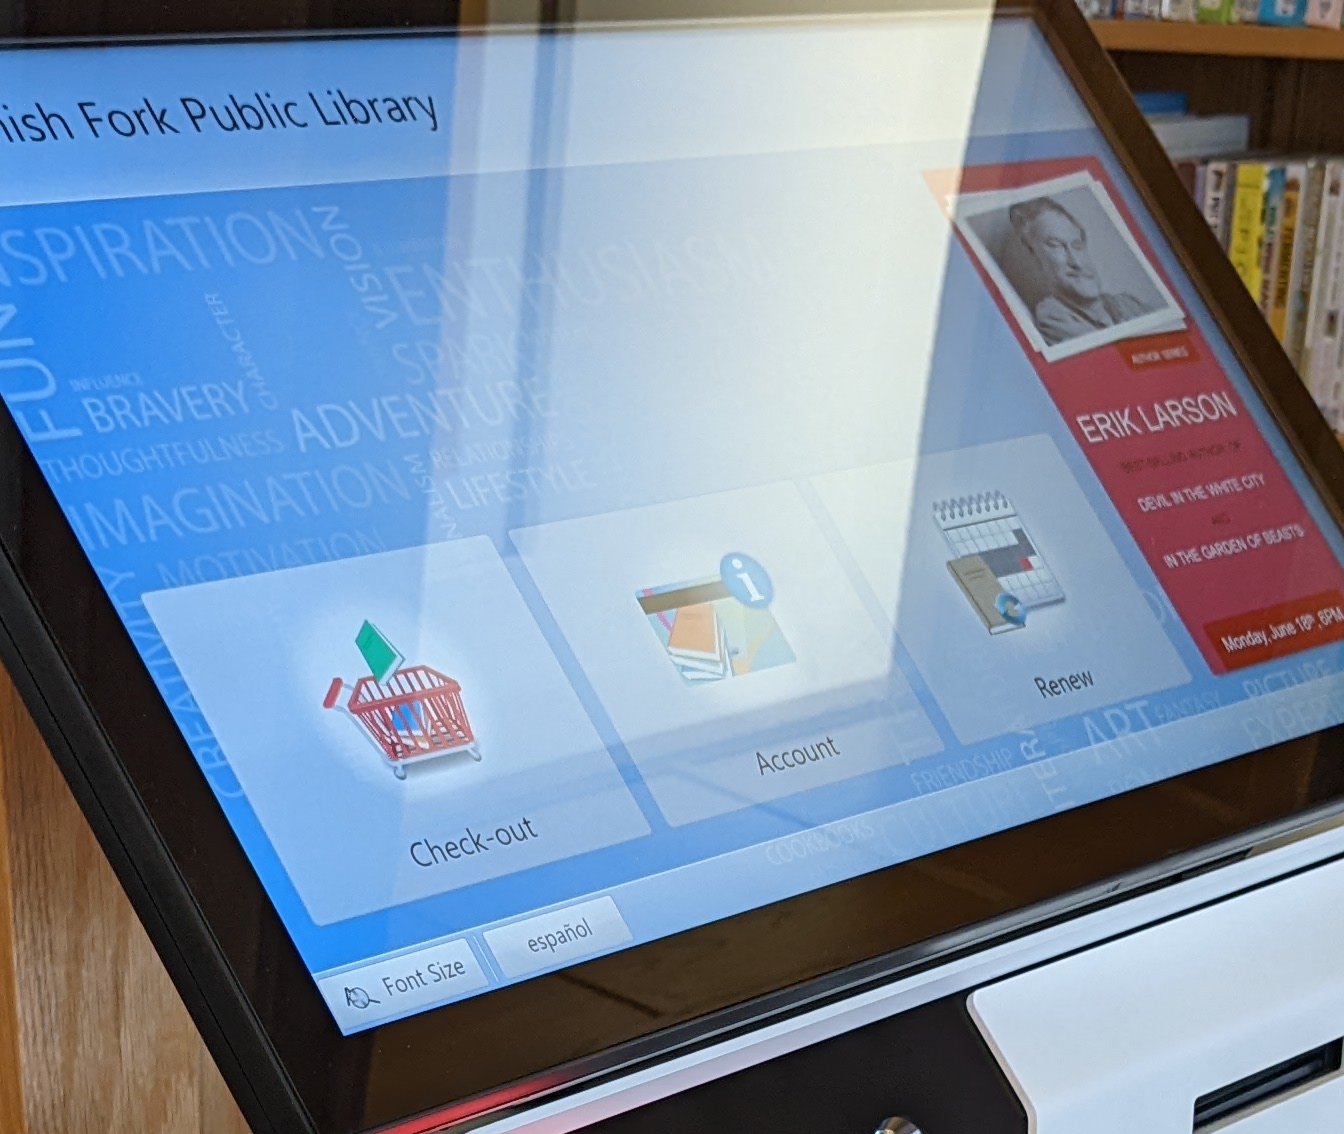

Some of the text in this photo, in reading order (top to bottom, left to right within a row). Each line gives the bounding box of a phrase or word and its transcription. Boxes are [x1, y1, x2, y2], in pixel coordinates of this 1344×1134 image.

[84, 99, 181, 140] Fork
[188, 92, 308, 134] Public
[317, 89, 441, 131] Library
[312, 204, 398, 330] VISION
[205, 292, 280, 413] CHARACTER
[390, 328, 522, 388] SPARK
[80, 379, 253, 435] BRAVERY
[291, 379, 560, 454] ADVENTURE
[1076, 391, 1238, 443] ERIK LARSON
[43, 429, 285, 484] THOUGHTFULNESS
[67, 457, 413, 553] IMAGINATION
[442, 458, 597, 512] LIFESTYLE
[1137, 472, 1266, 513] DEVIL IN THE WHITE CITY
[1163, 523, 1305, 569] IN THE GARDEN OF BEASTS
[1221, 628, 1272, 653] Monday,
[1269, 619, 1297, 643] June
[1033, 669, 1095, 699] Renew
[755, 735, 842, 776] Account
[1082, 699, 1162, 766] ART
[910, 747, 1013, 795] FRIENDSHIP
[410, 816, 538, 869] Check-out
[527, 917, 594, 955] español
[381, 956, 467, 998] Font Size
